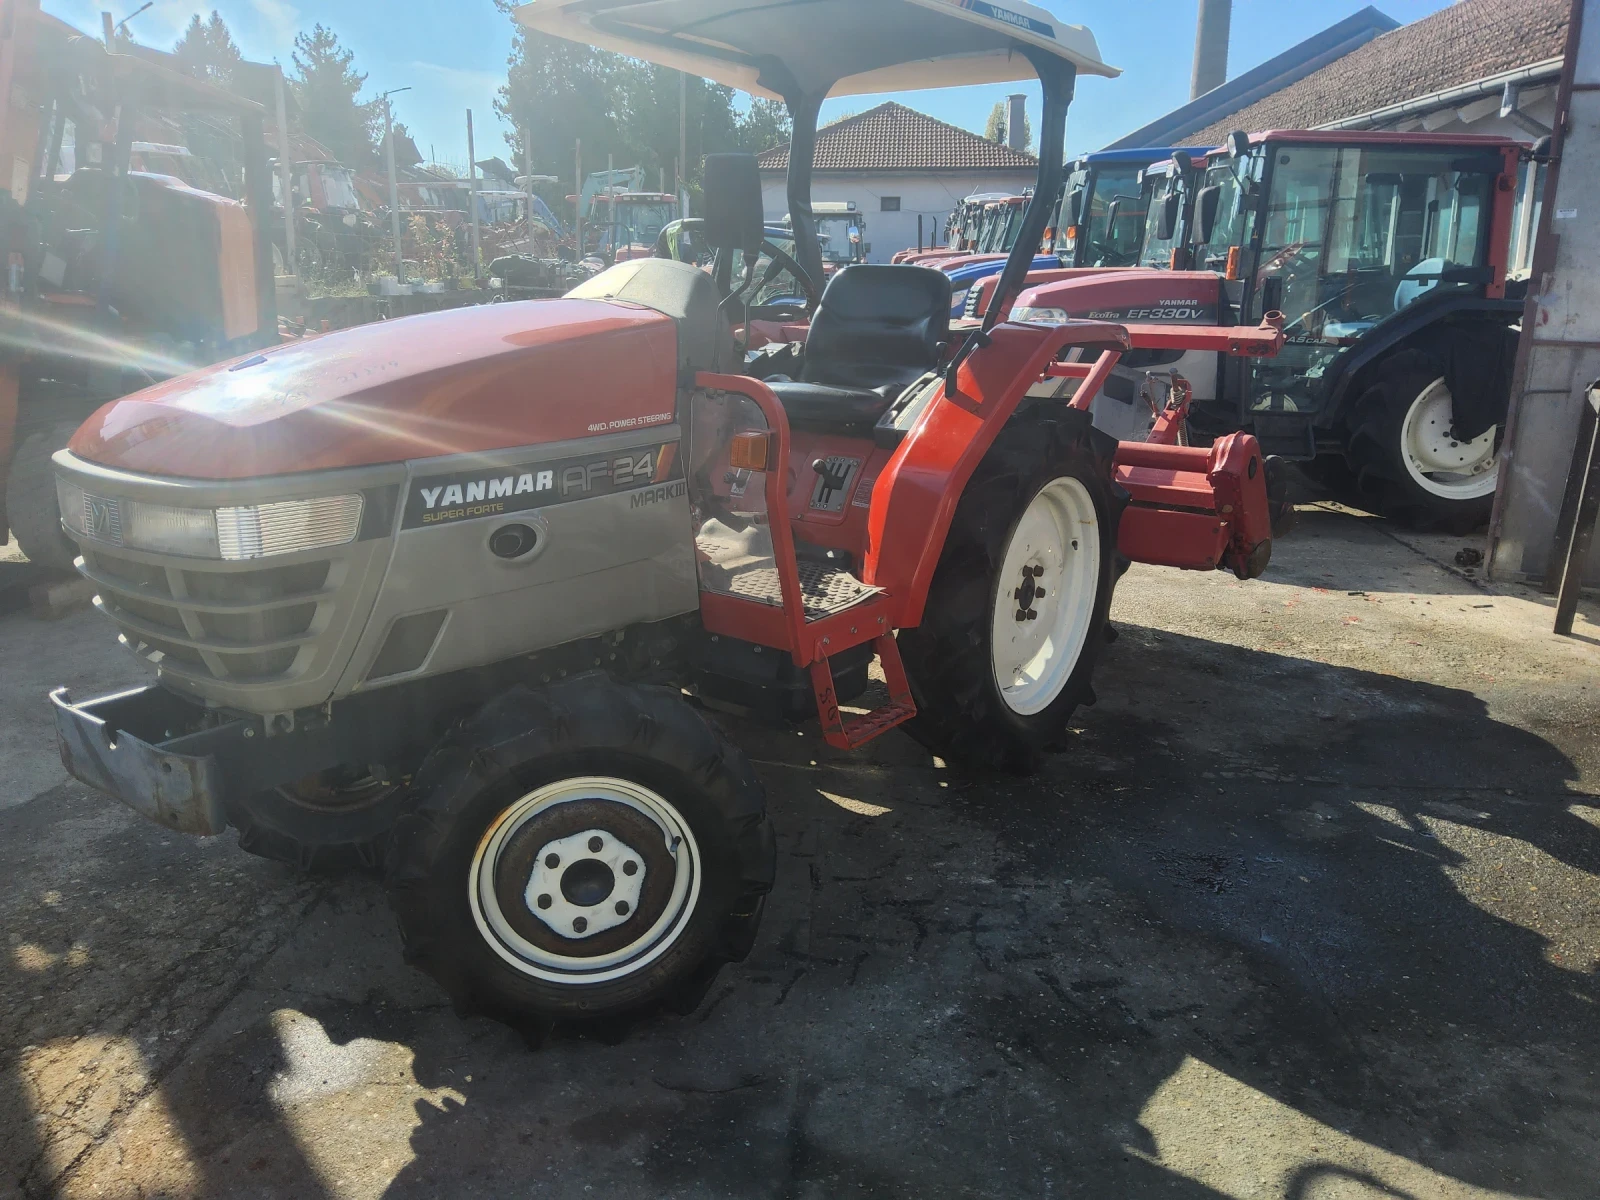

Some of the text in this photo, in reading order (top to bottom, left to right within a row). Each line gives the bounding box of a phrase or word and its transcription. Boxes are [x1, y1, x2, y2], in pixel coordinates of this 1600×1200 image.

[990, 5, 1031, 29] YANMAR
[1088, 308, 1204, 319] EcoTra EF330V
[637, 412, 672, 425] STEERING
[420, 470, 553, 509] YANMAR
[423, 502, 505, 523] SUPER FORTE
